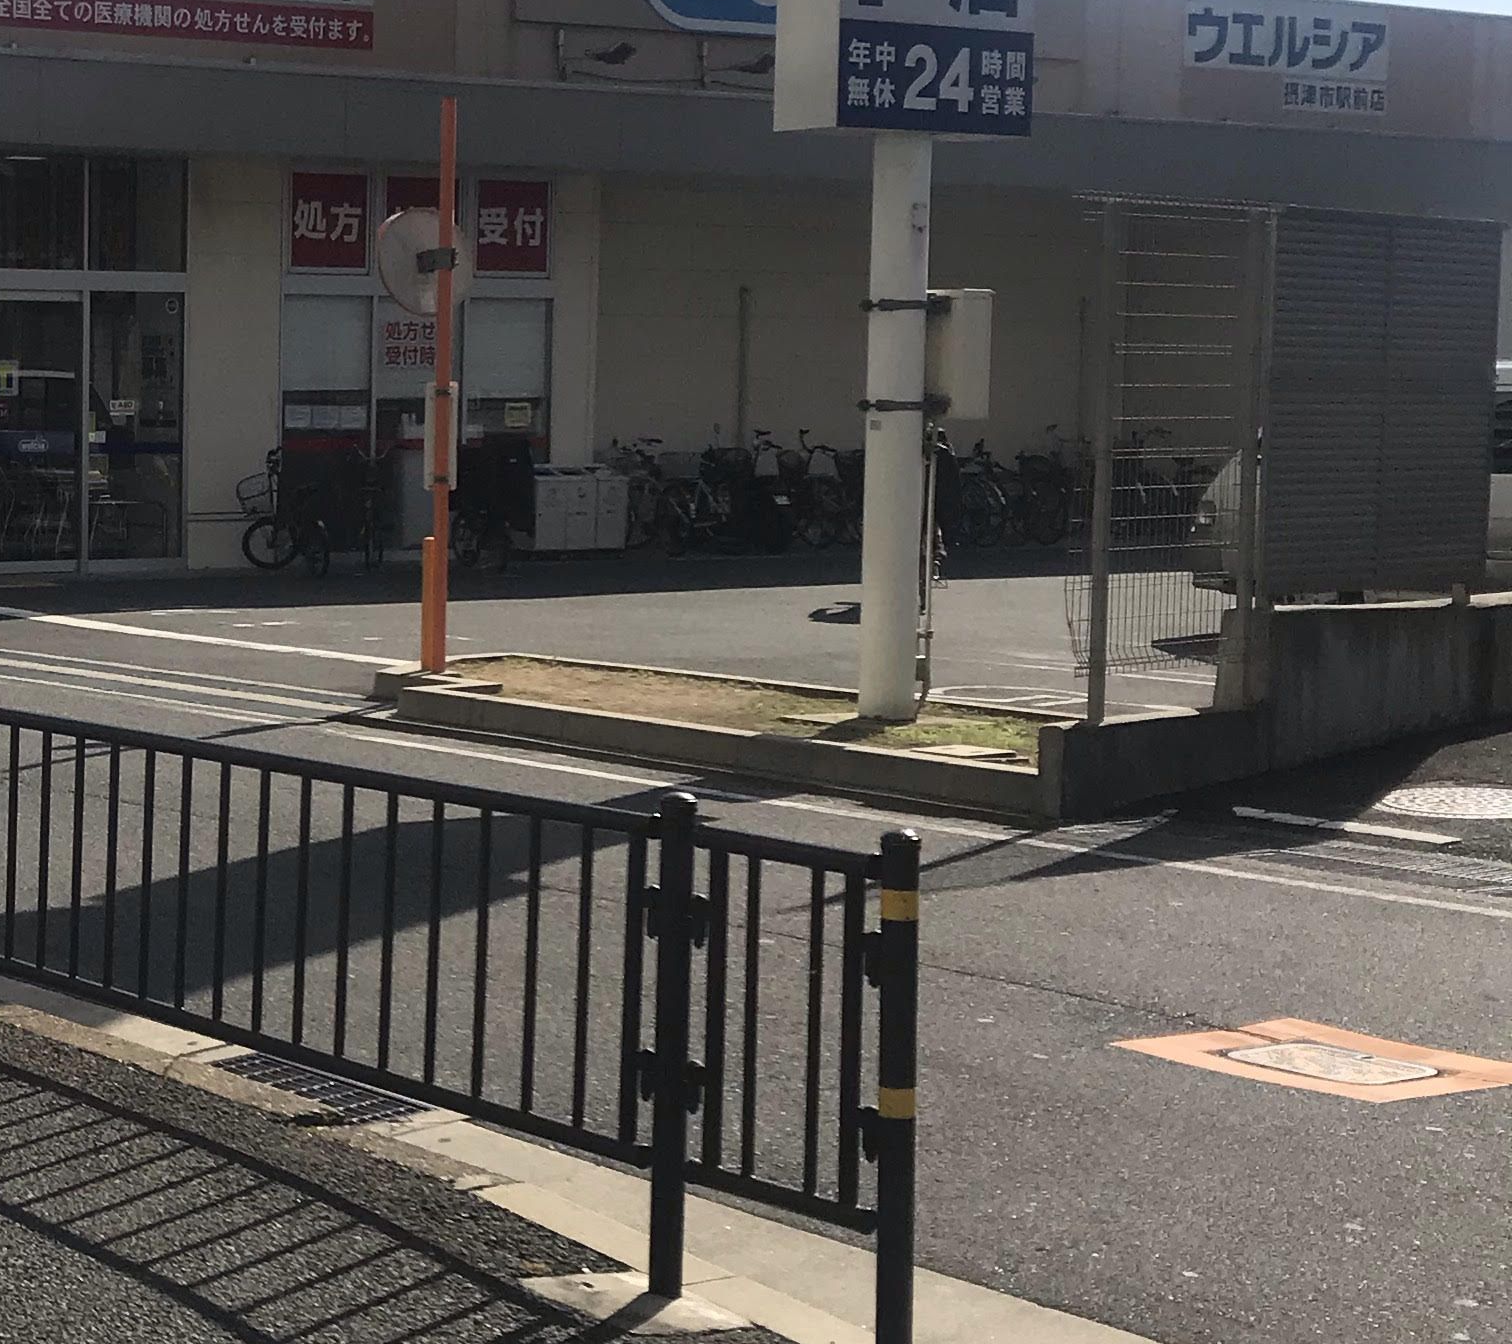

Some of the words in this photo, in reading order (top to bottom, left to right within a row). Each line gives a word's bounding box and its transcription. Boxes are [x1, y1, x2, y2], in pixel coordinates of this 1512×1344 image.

[1188, 7, 1387, 73] ウエルシア
[294, 199, 362, 243] 処方
[478, 206, 544, 248] 受付
